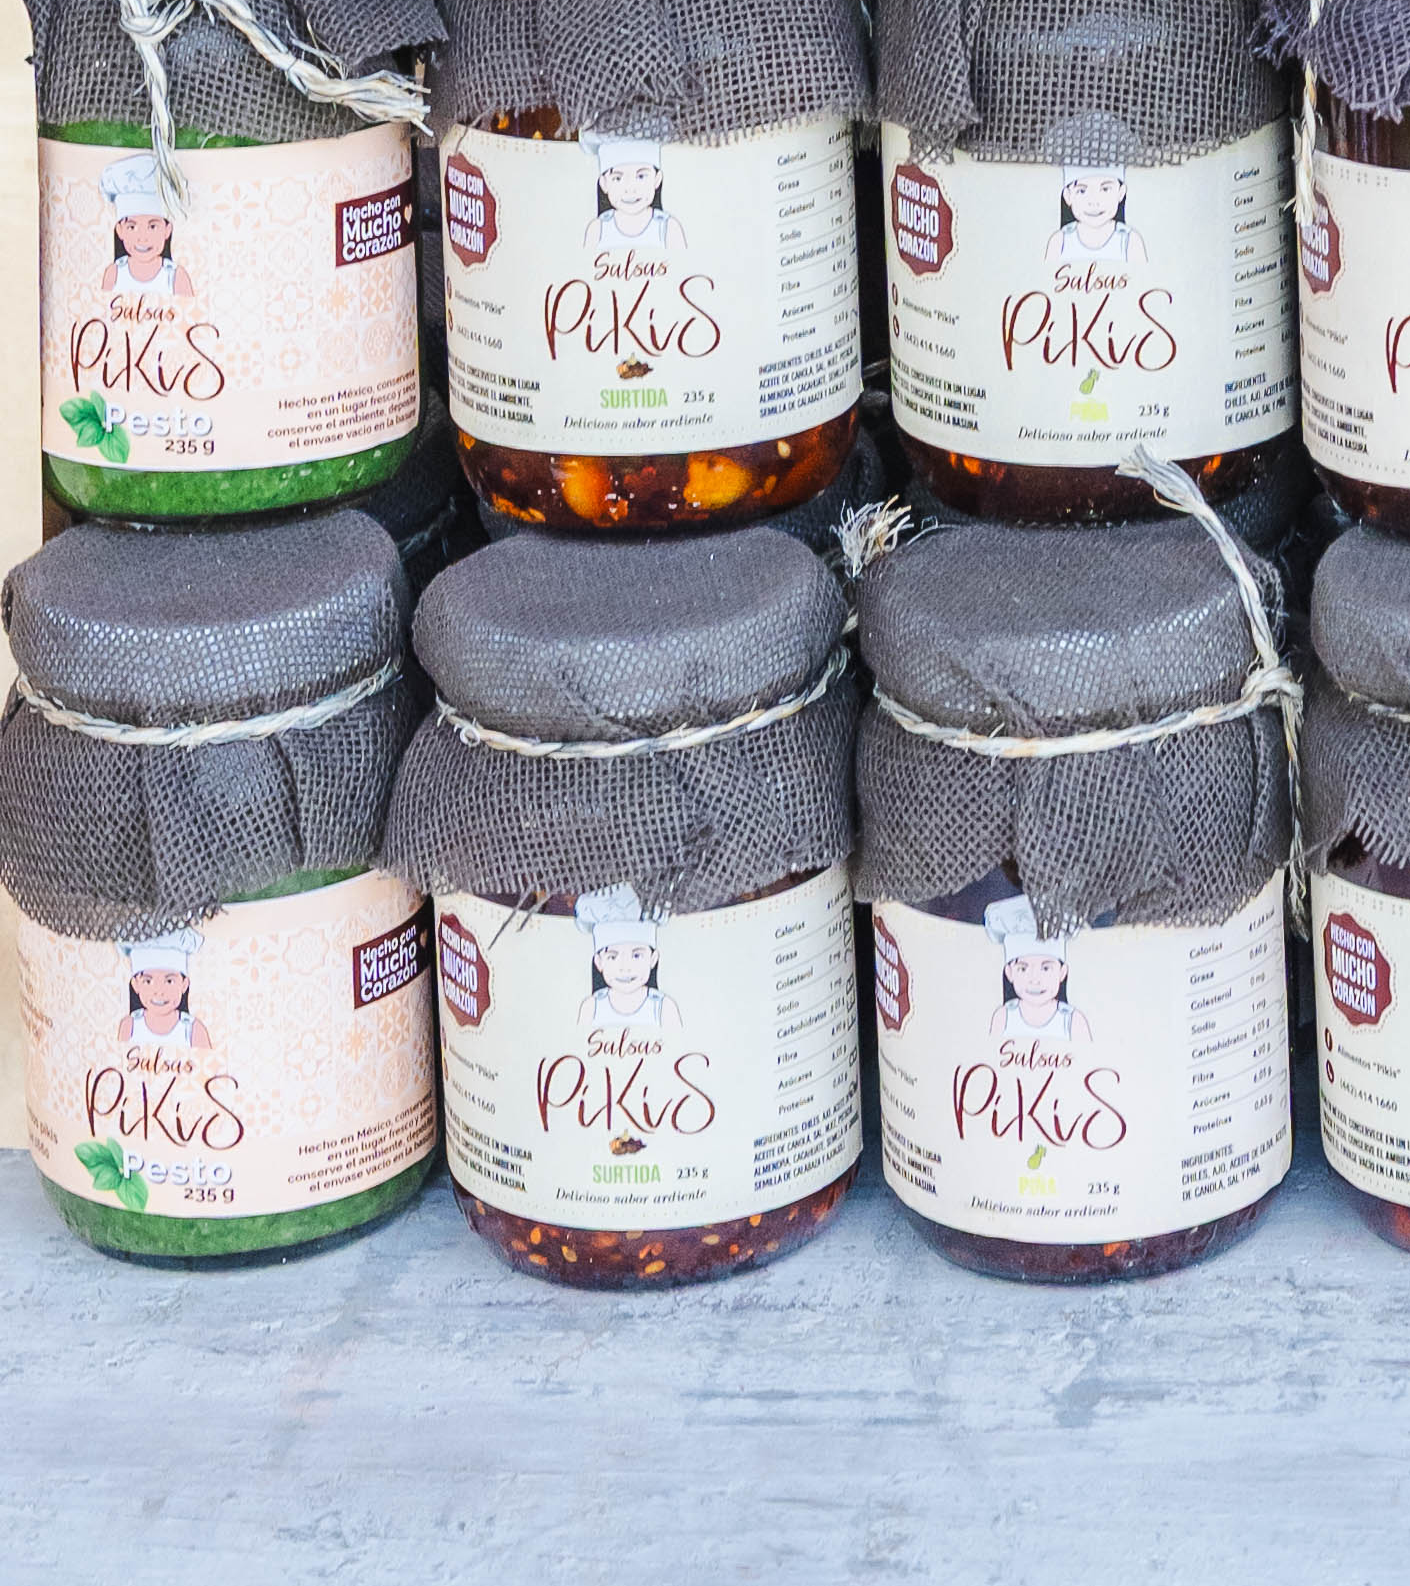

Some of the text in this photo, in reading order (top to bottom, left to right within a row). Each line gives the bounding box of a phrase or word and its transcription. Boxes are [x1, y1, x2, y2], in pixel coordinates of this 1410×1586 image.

[342, 207, 401, 243] Mucho
[898, 200, 939, 237] MUCHO
[594, 249, 668, 281] Salsas
[1054, 262, 1129, 294] Salsas
[110, 295, 175, 322] Salsas
[279, 396, 317, 409] Hecho
[600, 387, 715, 409] SURTIDA 235 g
[1138, 404, 1159, 417] 235
[1162, 407, 1170, 419] g
[105, 404, 213, 437] Pesto
[268, 423, 322, 438] conserve
[165, 439, 214, 455] 235 g
[304, 434, 343, 446] envase
[360, 937, 417, 984] Mucho
[1330, 947, 1376, 989] MUCHO
[587, 1028, 664, 1058] Salsas
[999, 1039, 1073, 1069] Salsas
[127, 1046, 193, 1074] Salsas
[123, 1150, 233, 1186] Pesto
[592, 1164, 709, 1185] SURTIDA 235 g
[184, 1188, 234, 1203] 235 g
[1087, 1182, 1112, 1194] 235
[1114, 1184, 1120, 1195] g
